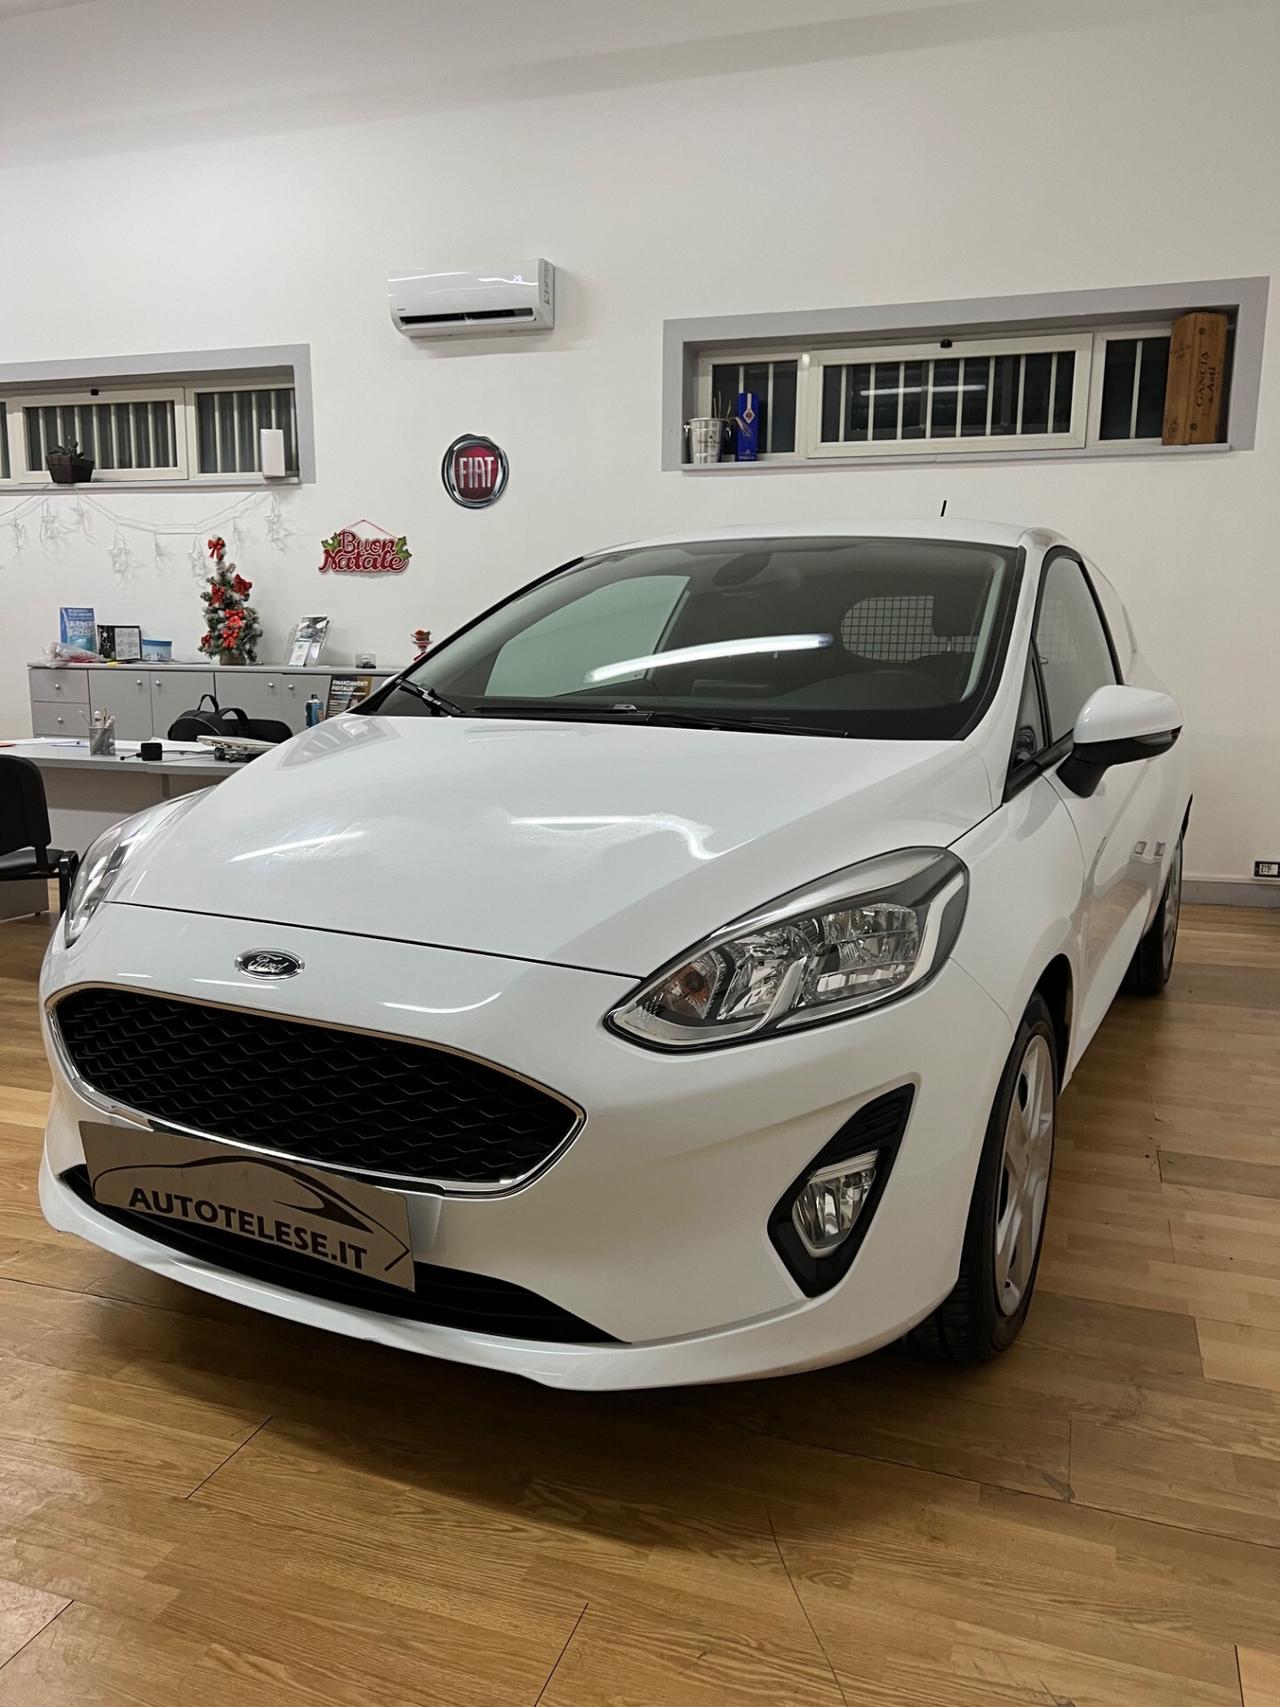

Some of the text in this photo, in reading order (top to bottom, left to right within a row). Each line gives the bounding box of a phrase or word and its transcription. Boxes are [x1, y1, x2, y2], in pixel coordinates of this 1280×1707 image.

[1195, 352, 1210, 407] GANCIA
[1207, 367, 1217, 393] Asti
[459, 456, 494, 488] FIAT
[338, 530, 396, 553] Buon
[319, 549, 408, 573] Natale
[248, 954, 288, 975] Ford
[129, 1187, 368, 1270] AUTOTELESE.IT
